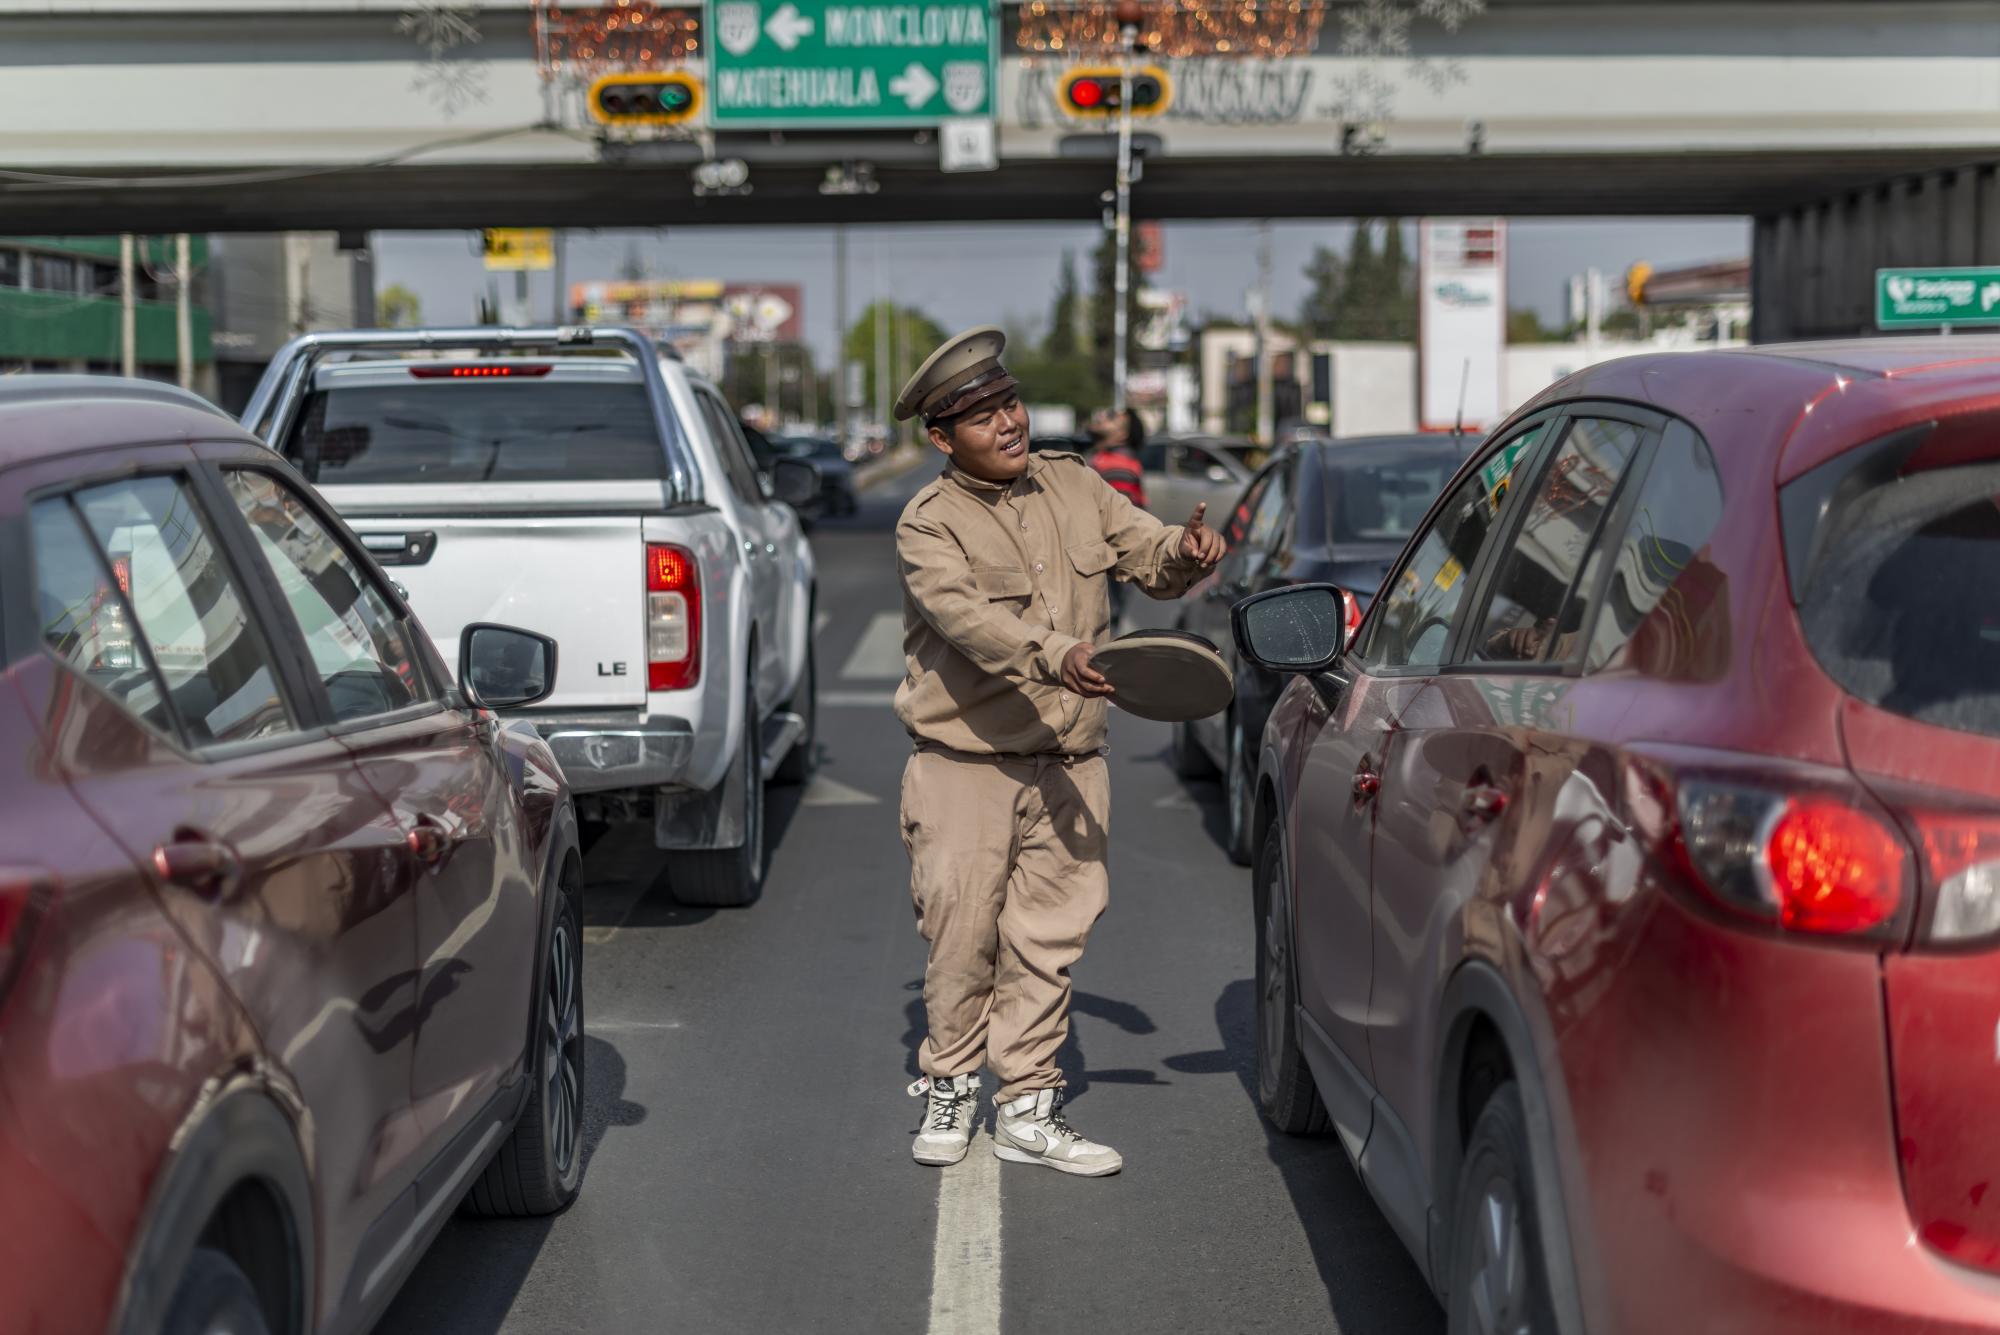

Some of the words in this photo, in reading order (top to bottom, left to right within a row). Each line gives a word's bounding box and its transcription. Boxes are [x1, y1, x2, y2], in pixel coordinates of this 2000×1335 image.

[824, 5, 988, 47] MONCLOVA
[717, 68, 881, 107] MATEHUALA
[597, 661, 627, 677] LE
